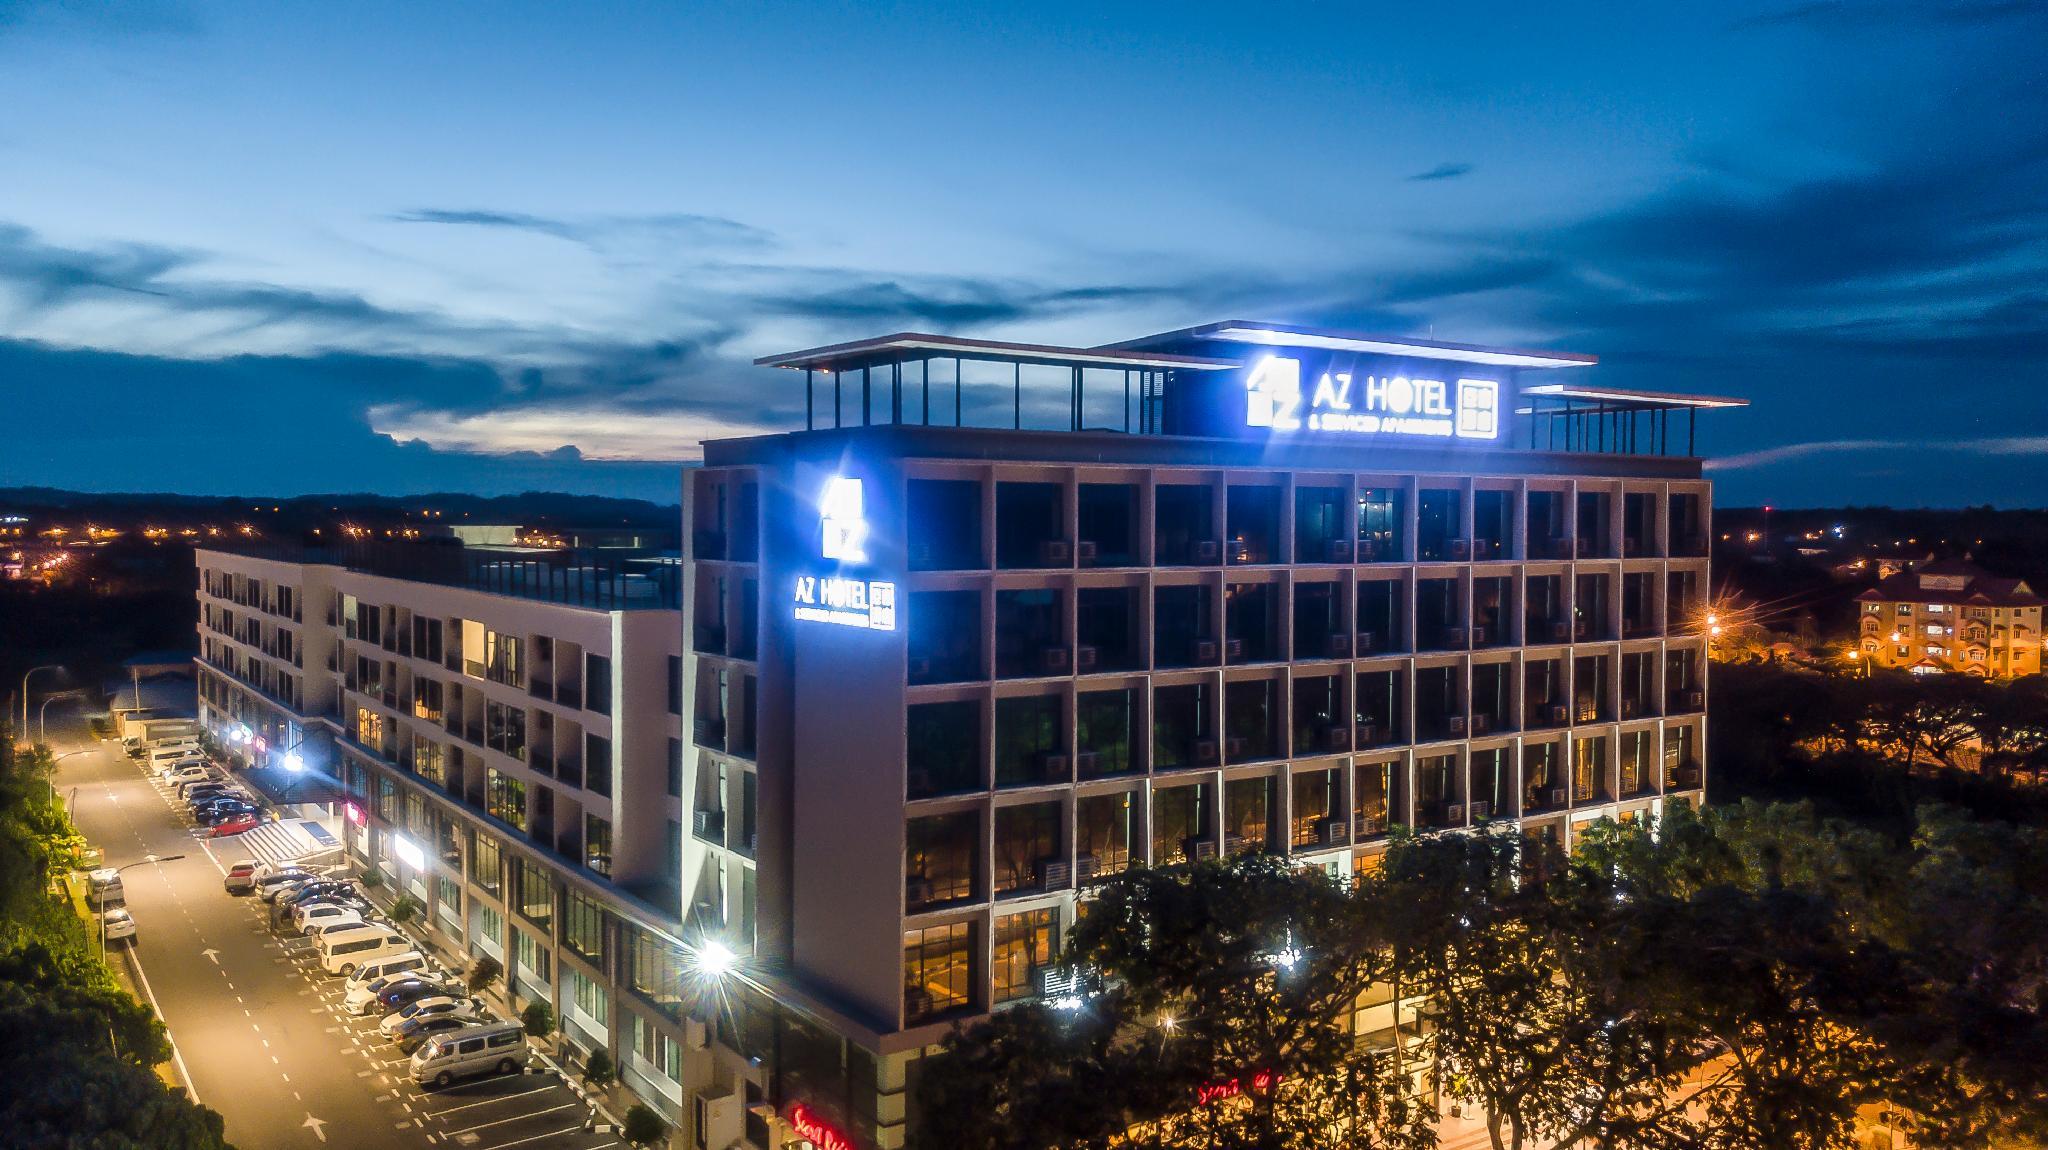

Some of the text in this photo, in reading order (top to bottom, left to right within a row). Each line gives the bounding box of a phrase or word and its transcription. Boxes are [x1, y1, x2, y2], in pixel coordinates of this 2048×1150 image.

[1312, 372, 1351, 410] AZ
[1367, 375, 1453, 416] HOTEL
[794, 576, 870, 610] AZ HOTEL
